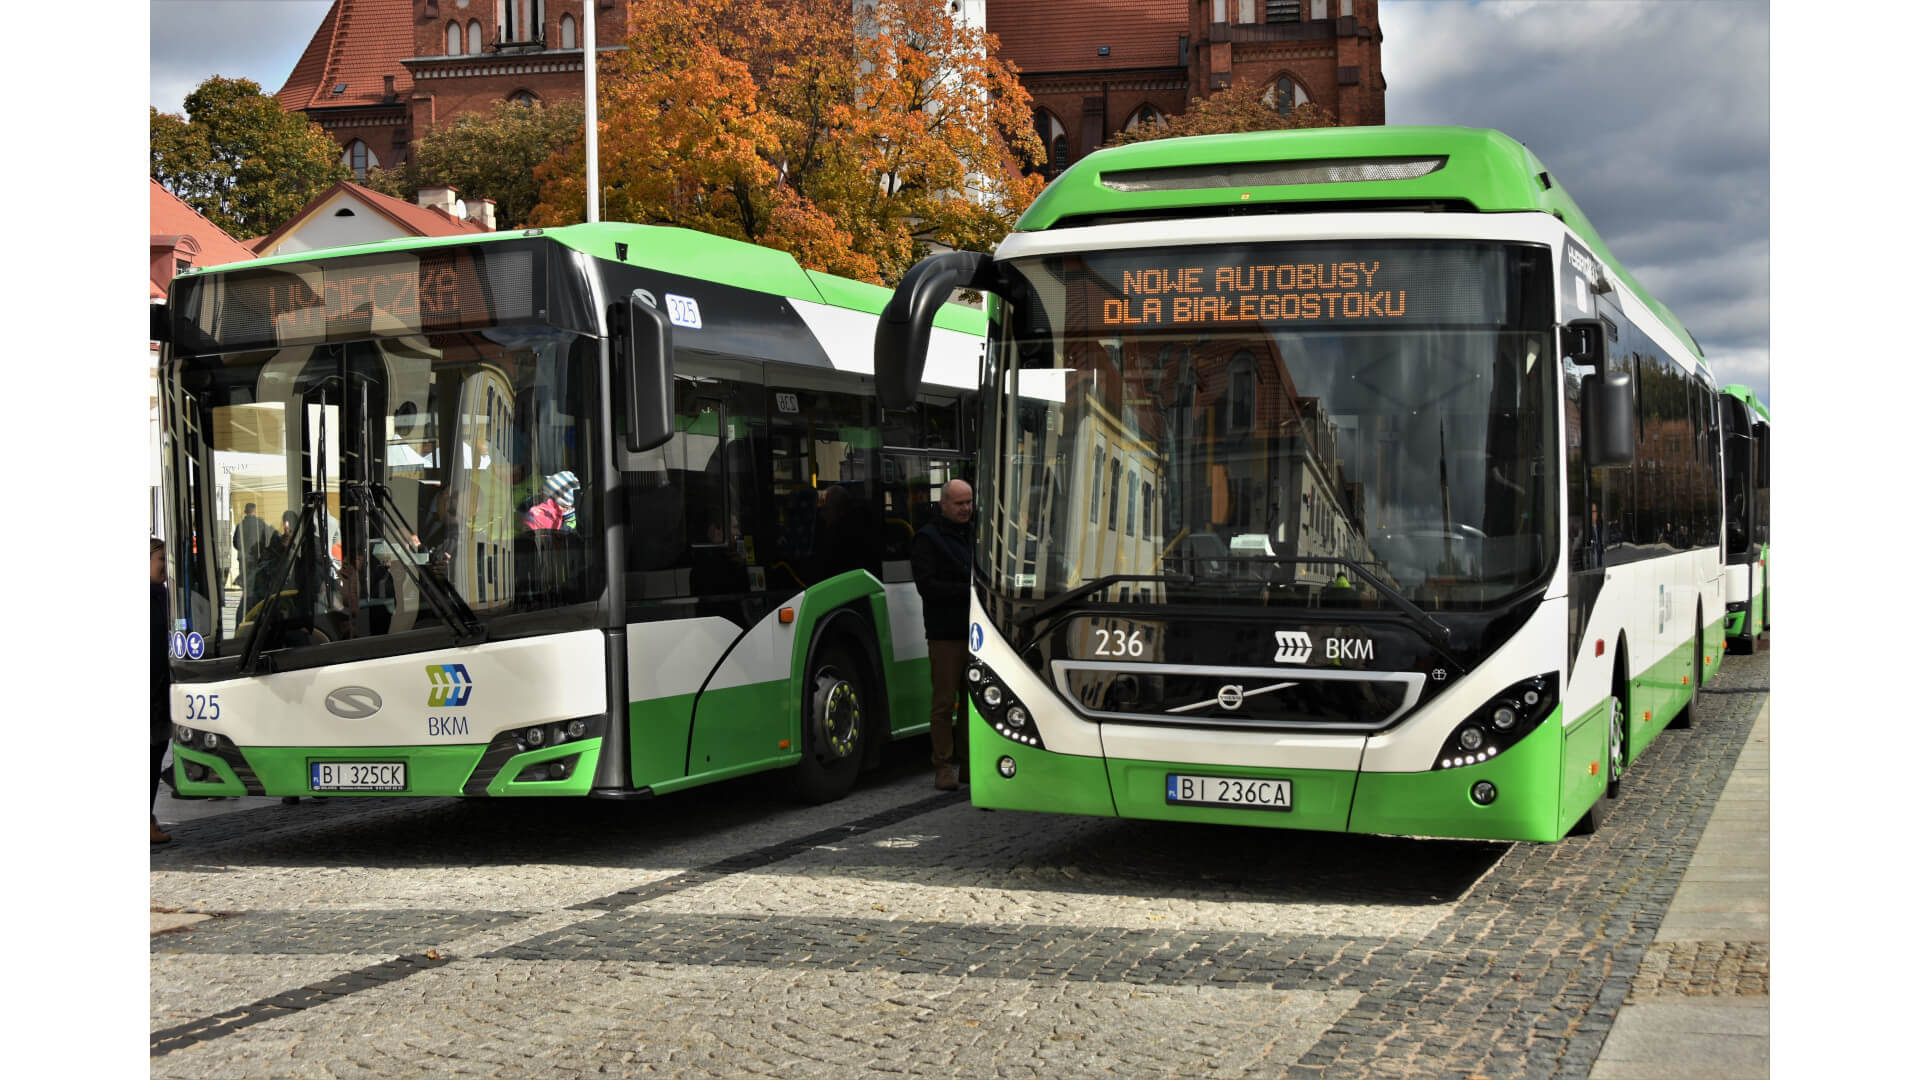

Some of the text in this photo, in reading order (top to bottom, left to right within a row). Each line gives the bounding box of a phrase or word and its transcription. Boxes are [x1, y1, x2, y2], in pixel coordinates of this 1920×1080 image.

[1123, 261, 1380, 294] NOWE AUTOBUSY
[268, 267, 458, 327] WYCIECZKA
[1103, 290, 1406, 324] DLA BIAŁEGOSTOKU
[671, 298, 697, 324] 325
[1095, 629, 1144, 656] 236
[1326, 638, 1374, 660] BKM
[185, 694, 220, 720] 325
[428, 716, 469, 736] BKM
[323, 766, 401, 785] BI 325CK
[1182, 778, 1286, 805] BI 236CA
